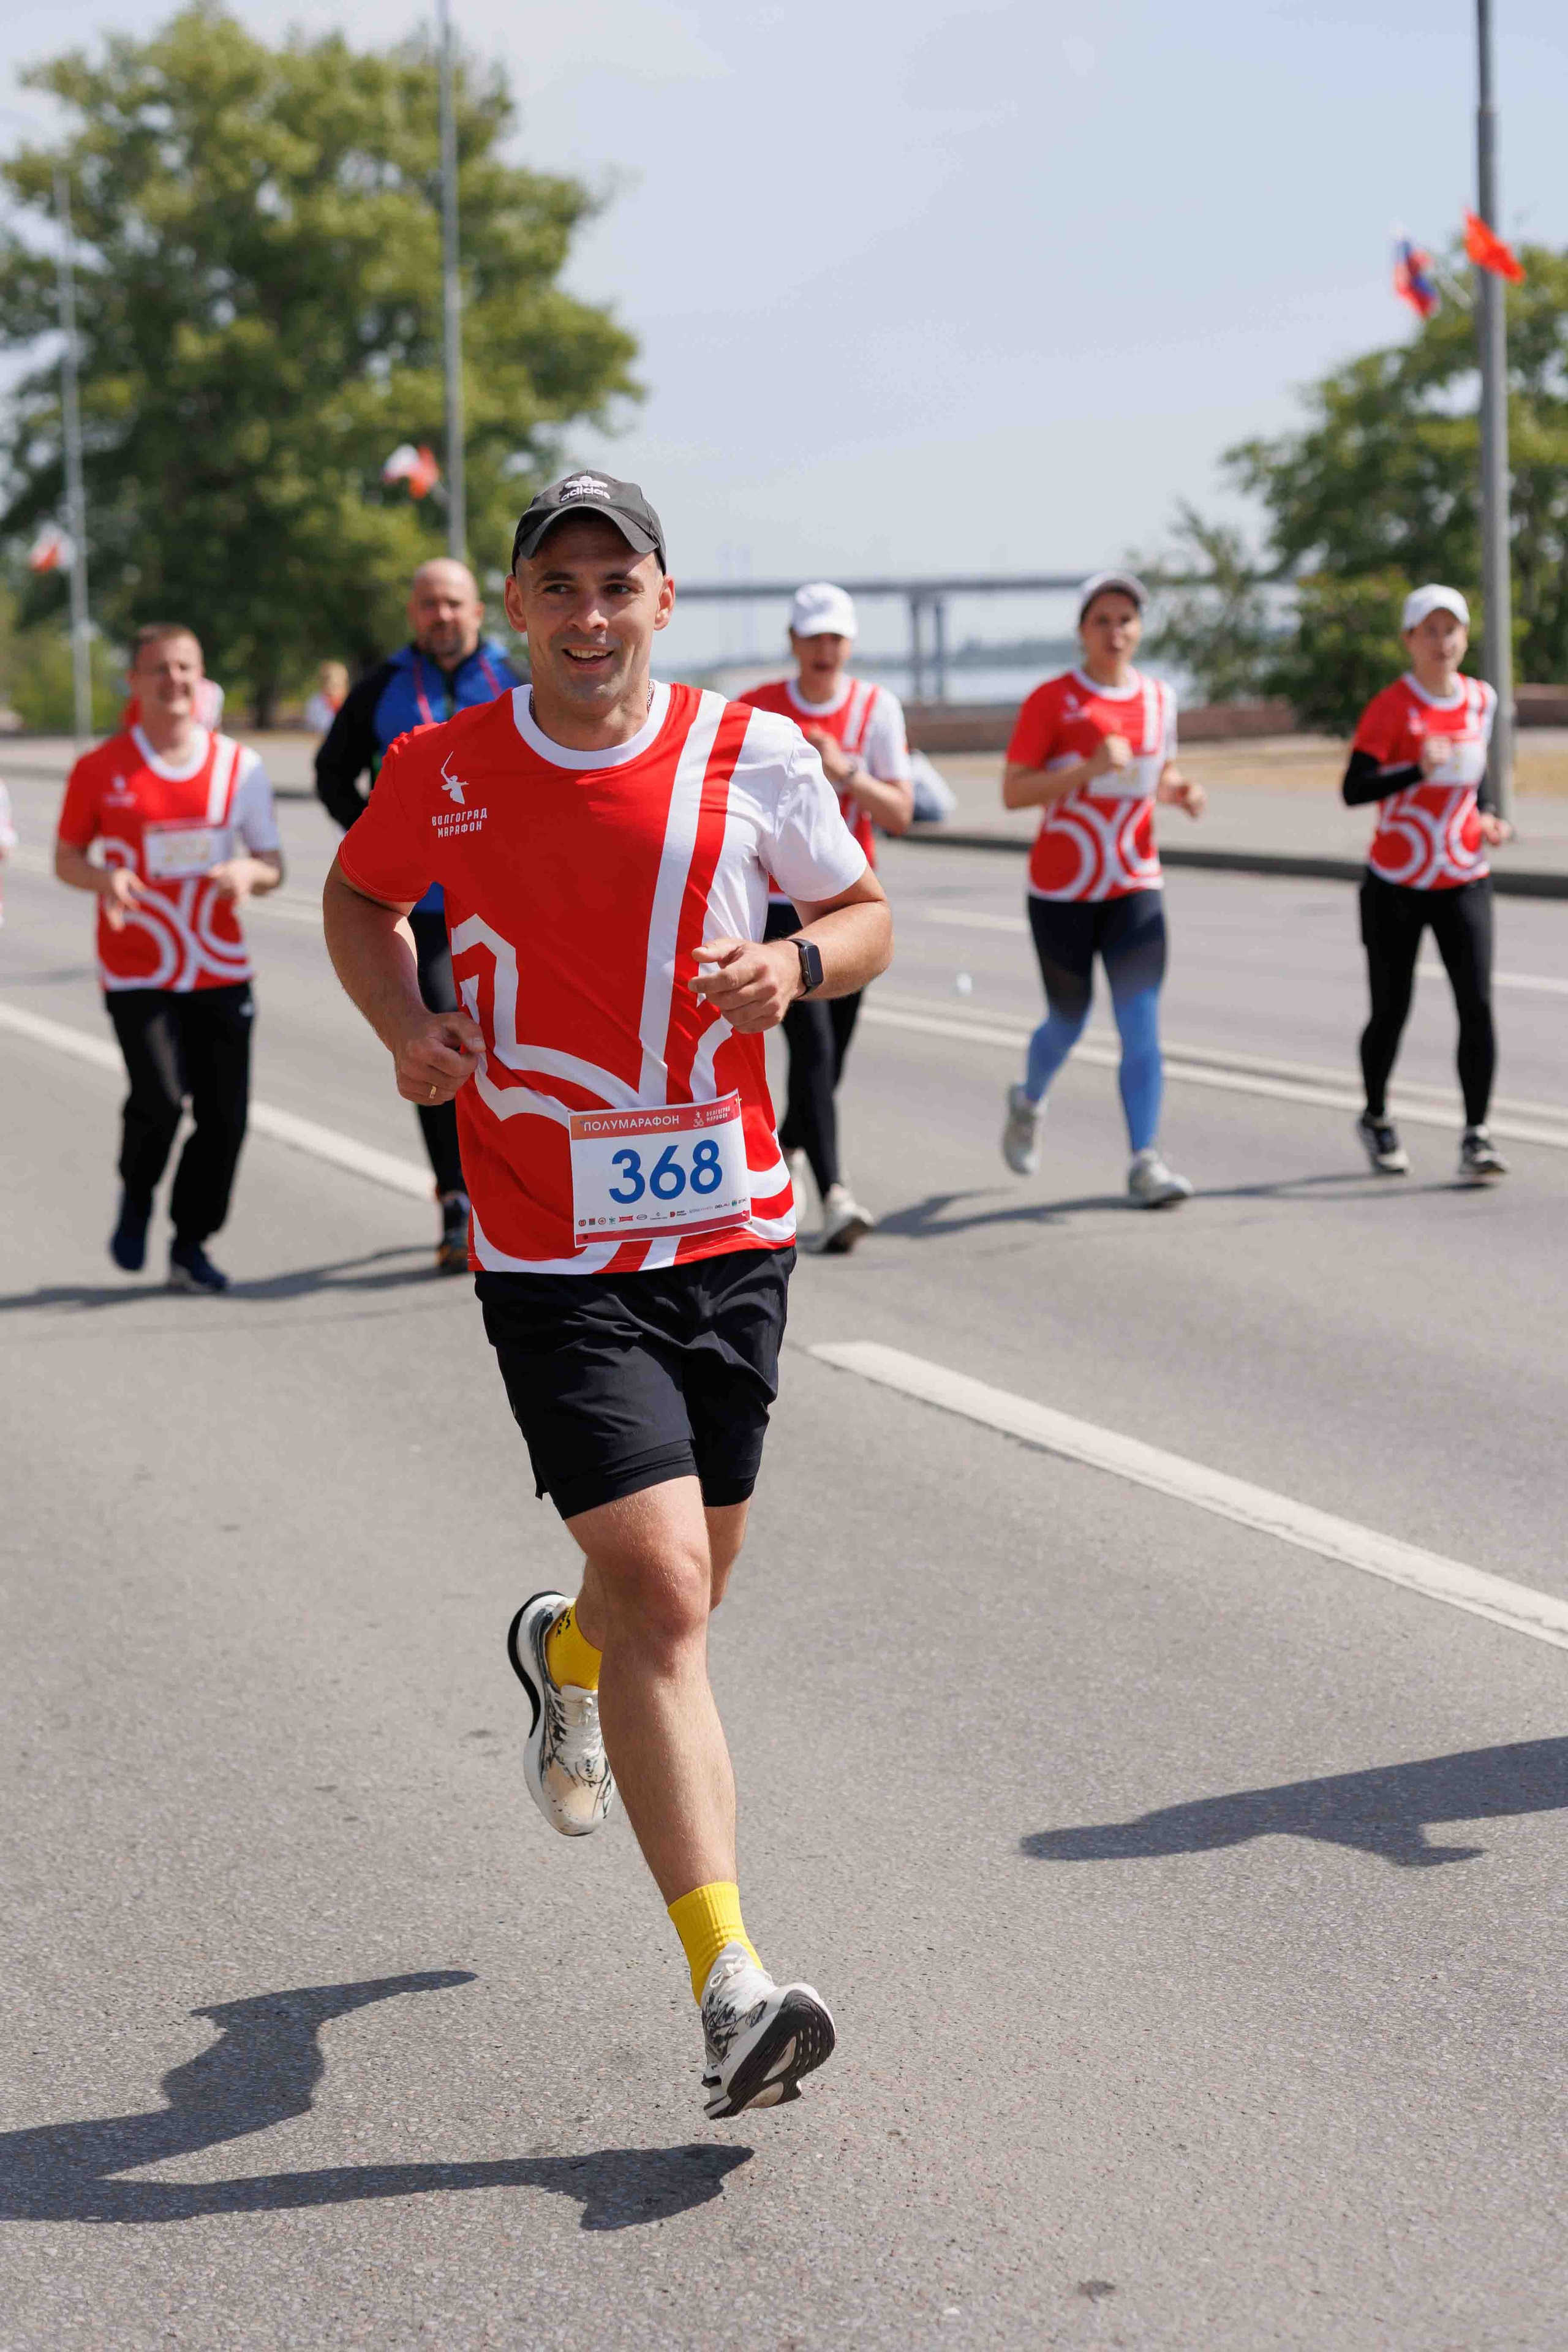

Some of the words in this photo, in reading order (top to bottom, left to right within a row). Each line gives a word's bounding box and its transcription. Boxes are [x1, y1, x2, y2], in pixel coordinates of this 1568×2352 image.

[432, 808, 487, 826] ВОЛГОГРАД
[438, 821, 482, 838] МАРАФОН
[584, 1115, 679, 1131] ПОЛУМАРАФОН
[609, 1139, 722, 1204] 368
